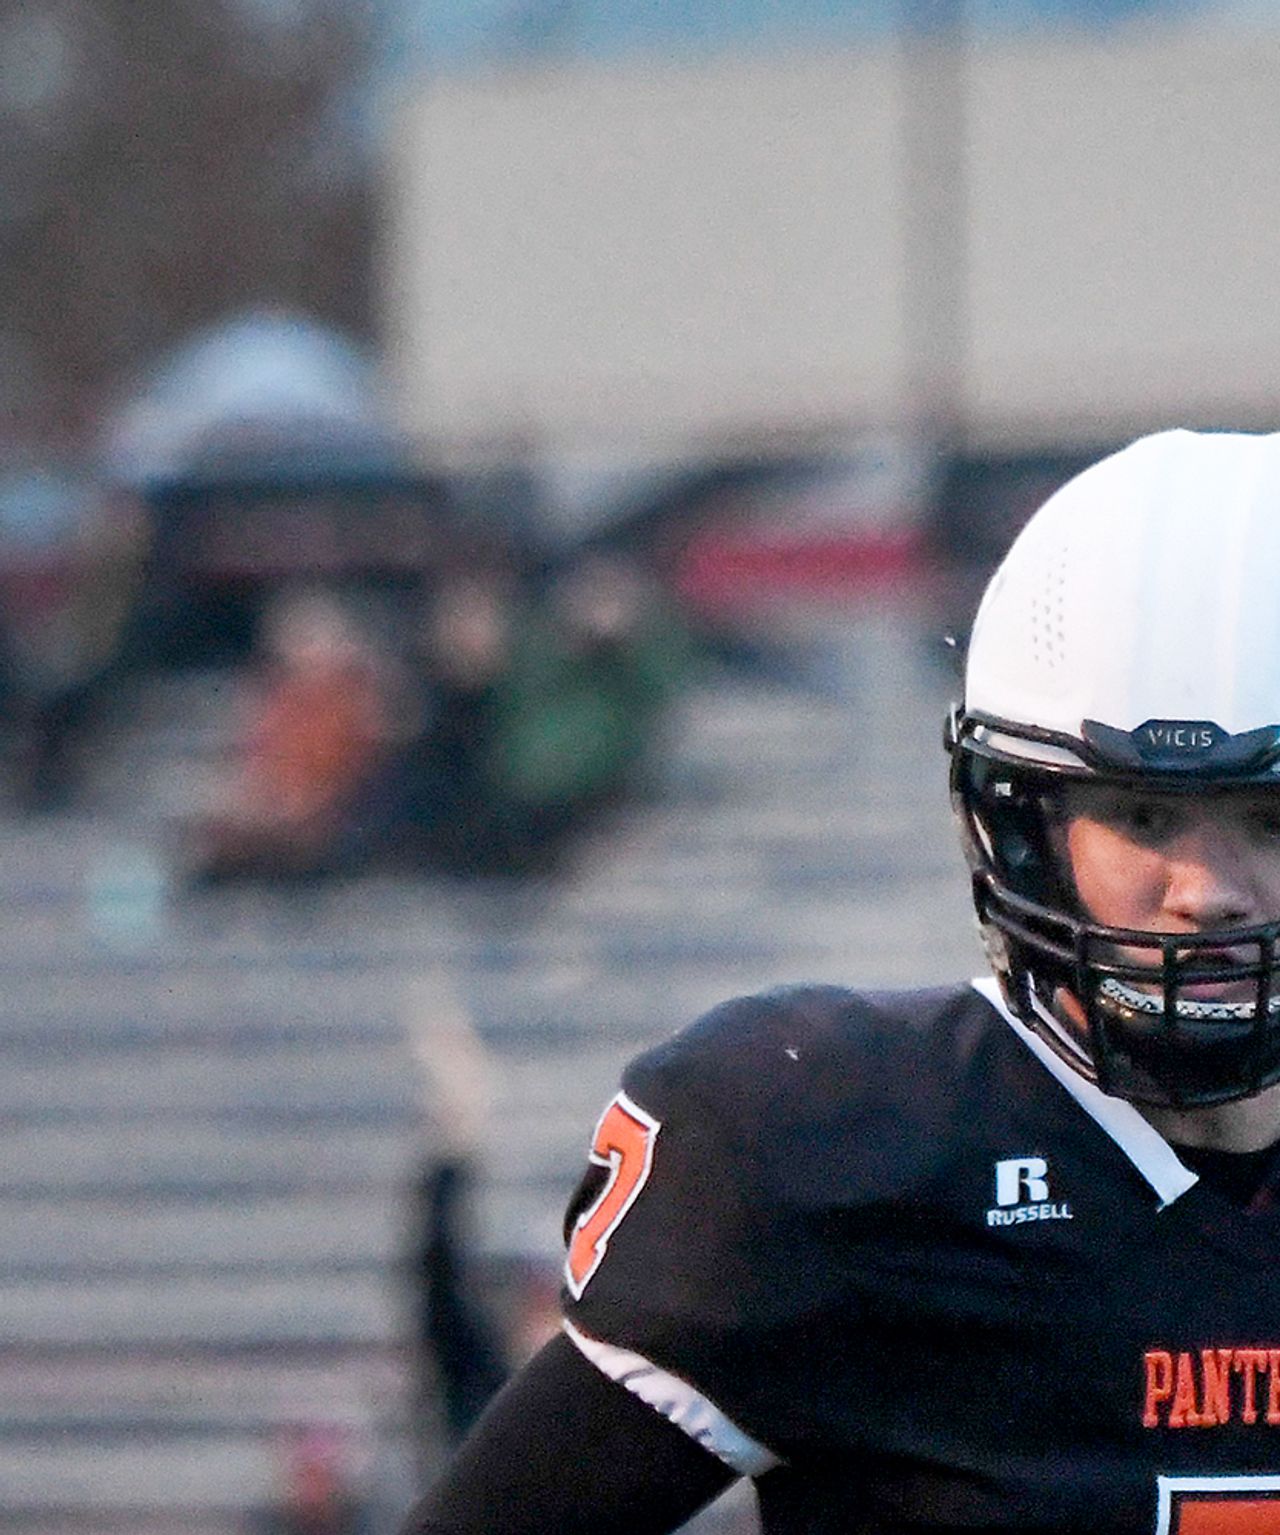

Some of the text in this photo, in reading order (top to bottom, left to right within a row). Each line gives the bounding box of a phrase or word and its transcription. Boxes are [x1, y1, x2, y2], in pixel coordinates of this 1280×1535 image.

[1149, 729, 1212, 747] VICIS
[565, 1090, 661, 1301] 7
[996, 1158, 1049, 1206] R
[987, 1204, 1074, 1226] RUSSELL
